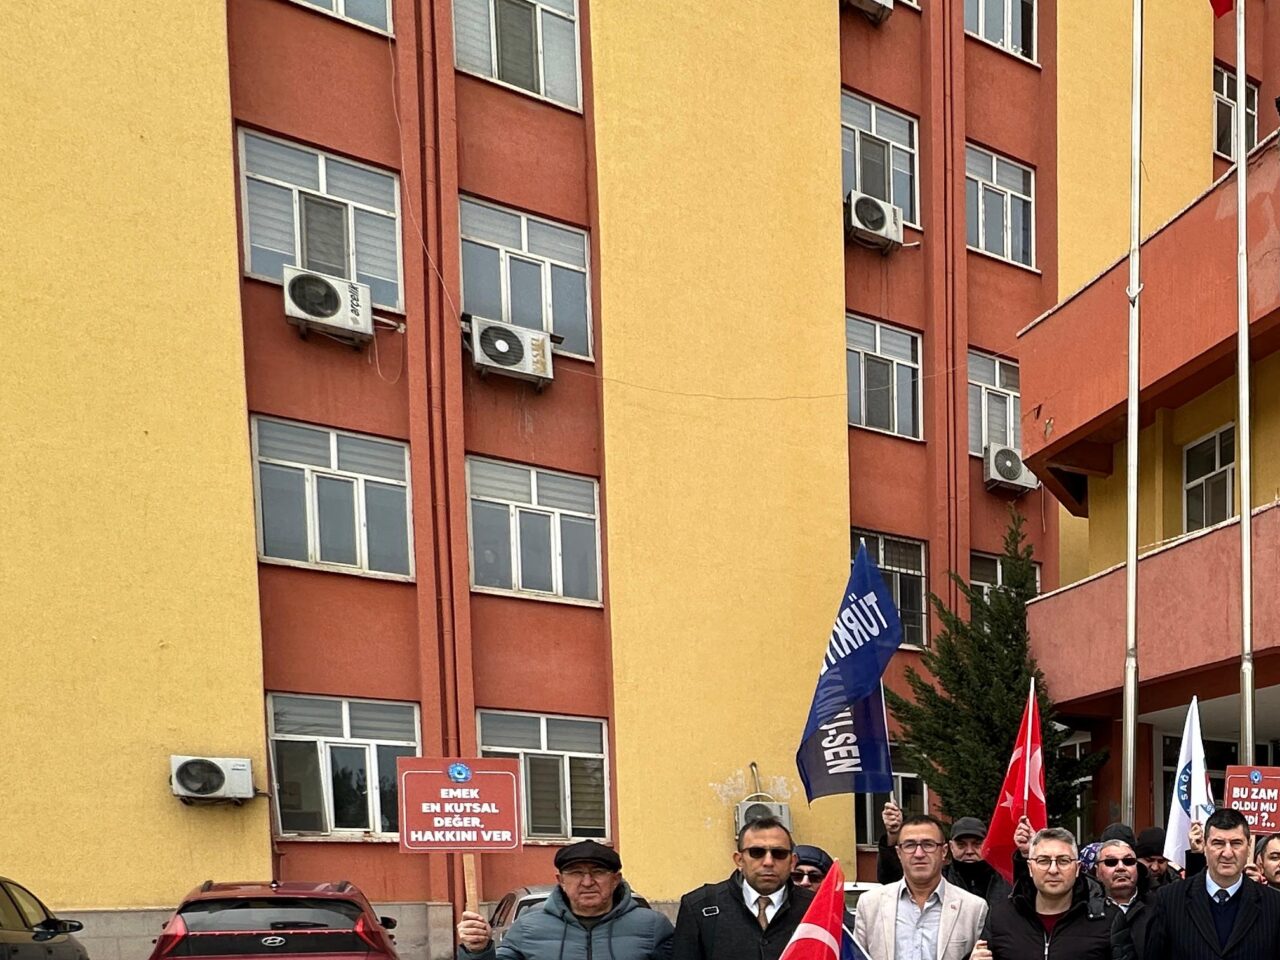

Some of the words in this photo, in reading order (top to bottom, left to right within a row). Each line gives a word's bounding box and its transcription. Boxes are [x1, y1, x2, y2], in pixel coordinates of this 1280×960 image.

[440, 788, 480, 799] EMEK
[1232, 787, 1248, 798] BU
[1250, 788, 1279, 800] ZAM
[421, 803, 441, 813] EN
[444, 803, 499, 813] KUTSAL
[1231, 800, 1258, 811] OLDU
[1260, 802, 1277, 812] MU
[410, 831, 478, 841] HAKKINI
[481, 831, 512, 841] VER
